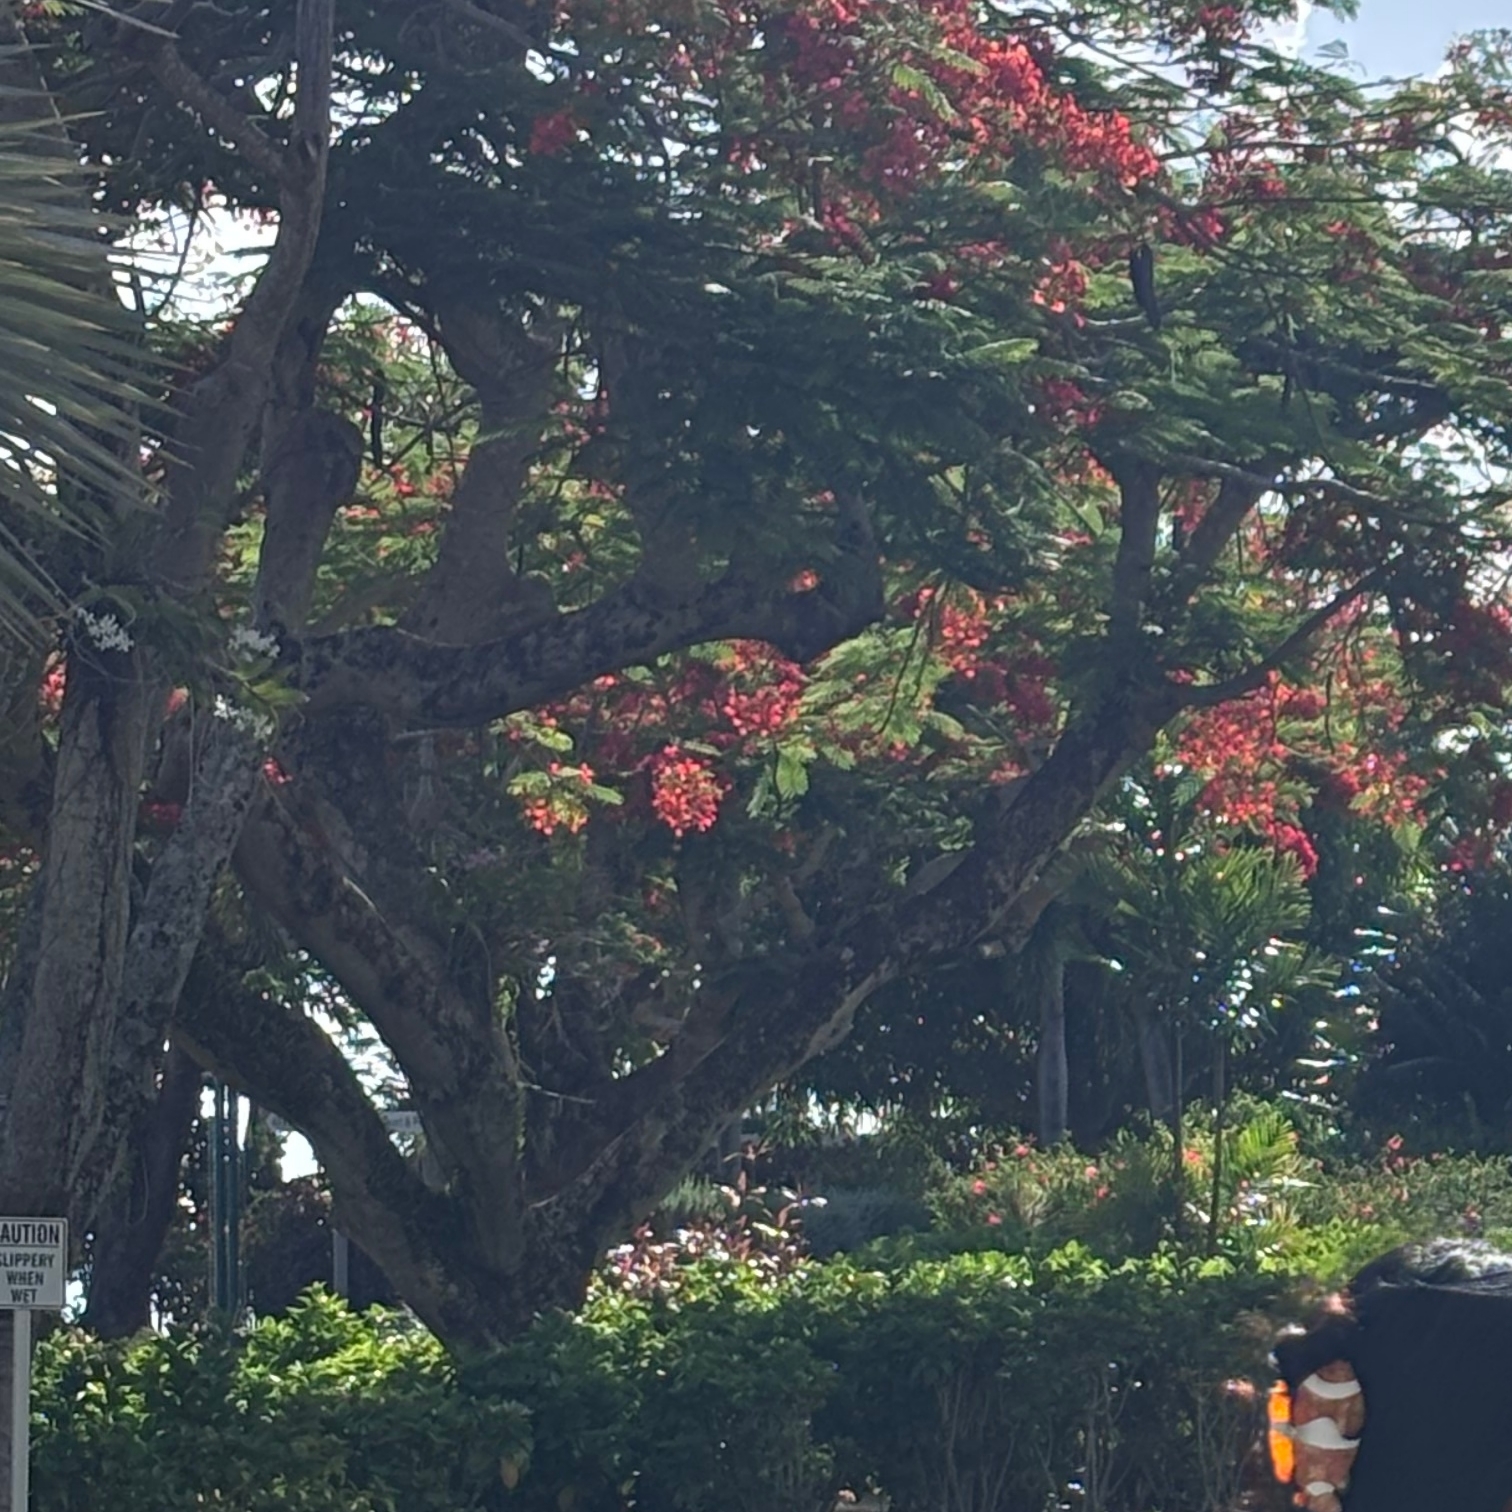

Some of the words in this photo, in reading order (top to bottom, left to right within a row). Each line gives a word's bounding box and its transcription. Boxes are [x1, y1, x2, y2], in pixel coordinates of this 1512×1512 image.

[0, 1223, 60, 1244] AUTION
[6, 1271, 44, 1286] WHEN
[10, 1288, 37, 1303] WET
